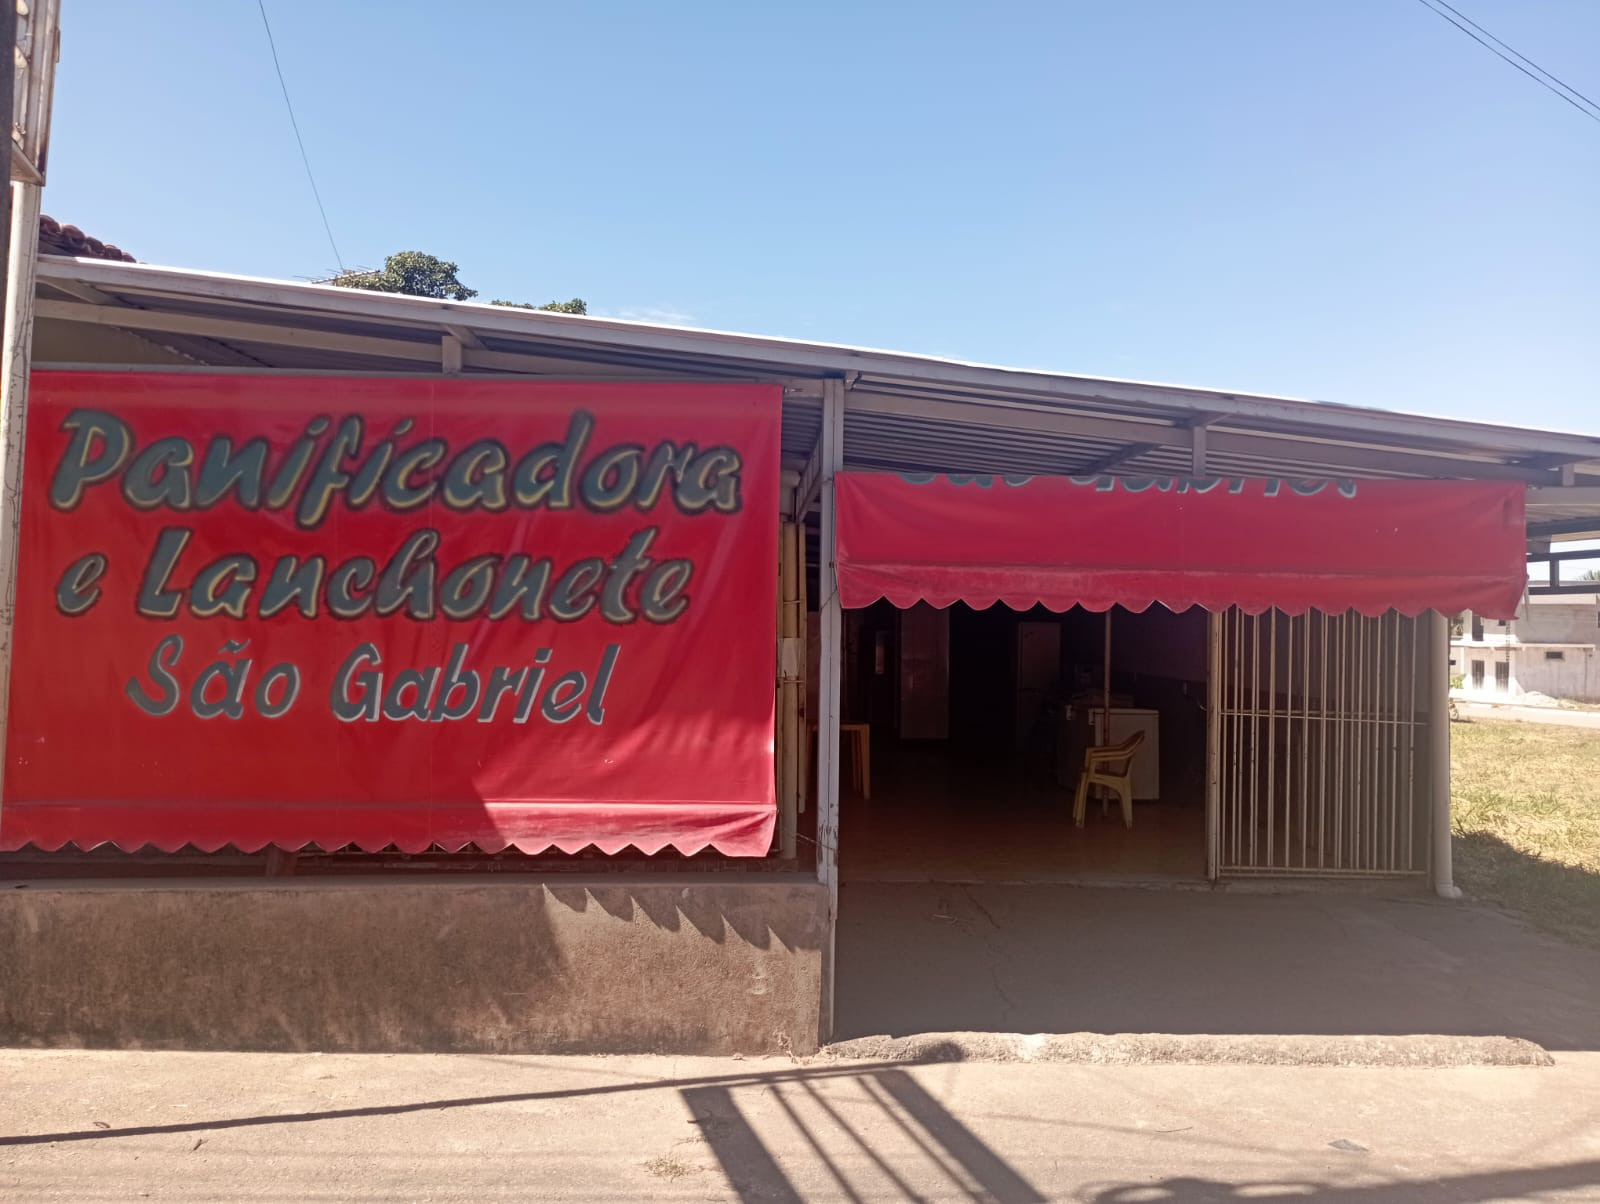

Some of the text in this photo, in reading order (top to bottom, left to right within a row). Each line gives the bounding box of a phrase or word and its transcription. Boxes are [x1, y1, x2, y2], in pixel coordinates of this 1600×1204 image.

[49, 408, 743, 530] Panificadora
[56, 527, 695, 624] e Lanchonete
[125, 634, 622, 726] São Gabriel
